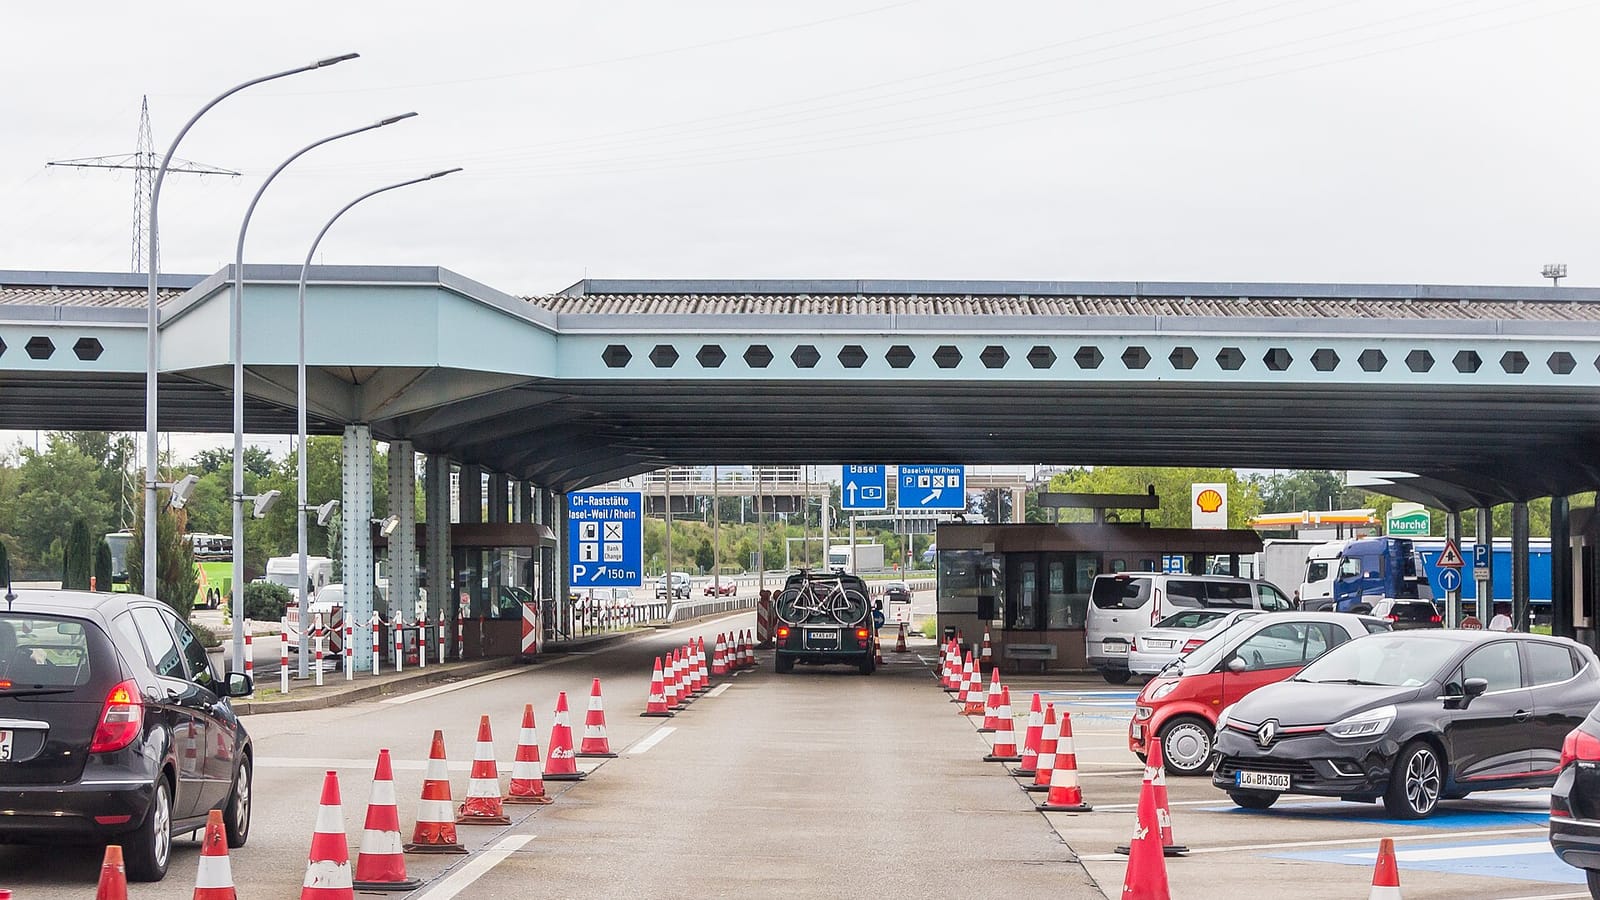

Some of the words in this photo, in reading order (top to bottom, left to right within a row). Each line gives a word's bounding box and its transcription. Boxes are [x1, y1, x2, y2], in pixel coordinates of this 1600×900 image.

[850, 465, 878, 474] Basel
[868, 488, 874, 497] 5
[573, 496, 629, 506] CH-Raststätte
[1391, 520, 1427, 529] Marché
[1476, 546, 1486, 561] P
[573, 564, 587, 583] P
[608, 569, 624, 579] 150
[626, 571, 636, 579] m
[1241, 772, 1252, 784] LÖ
